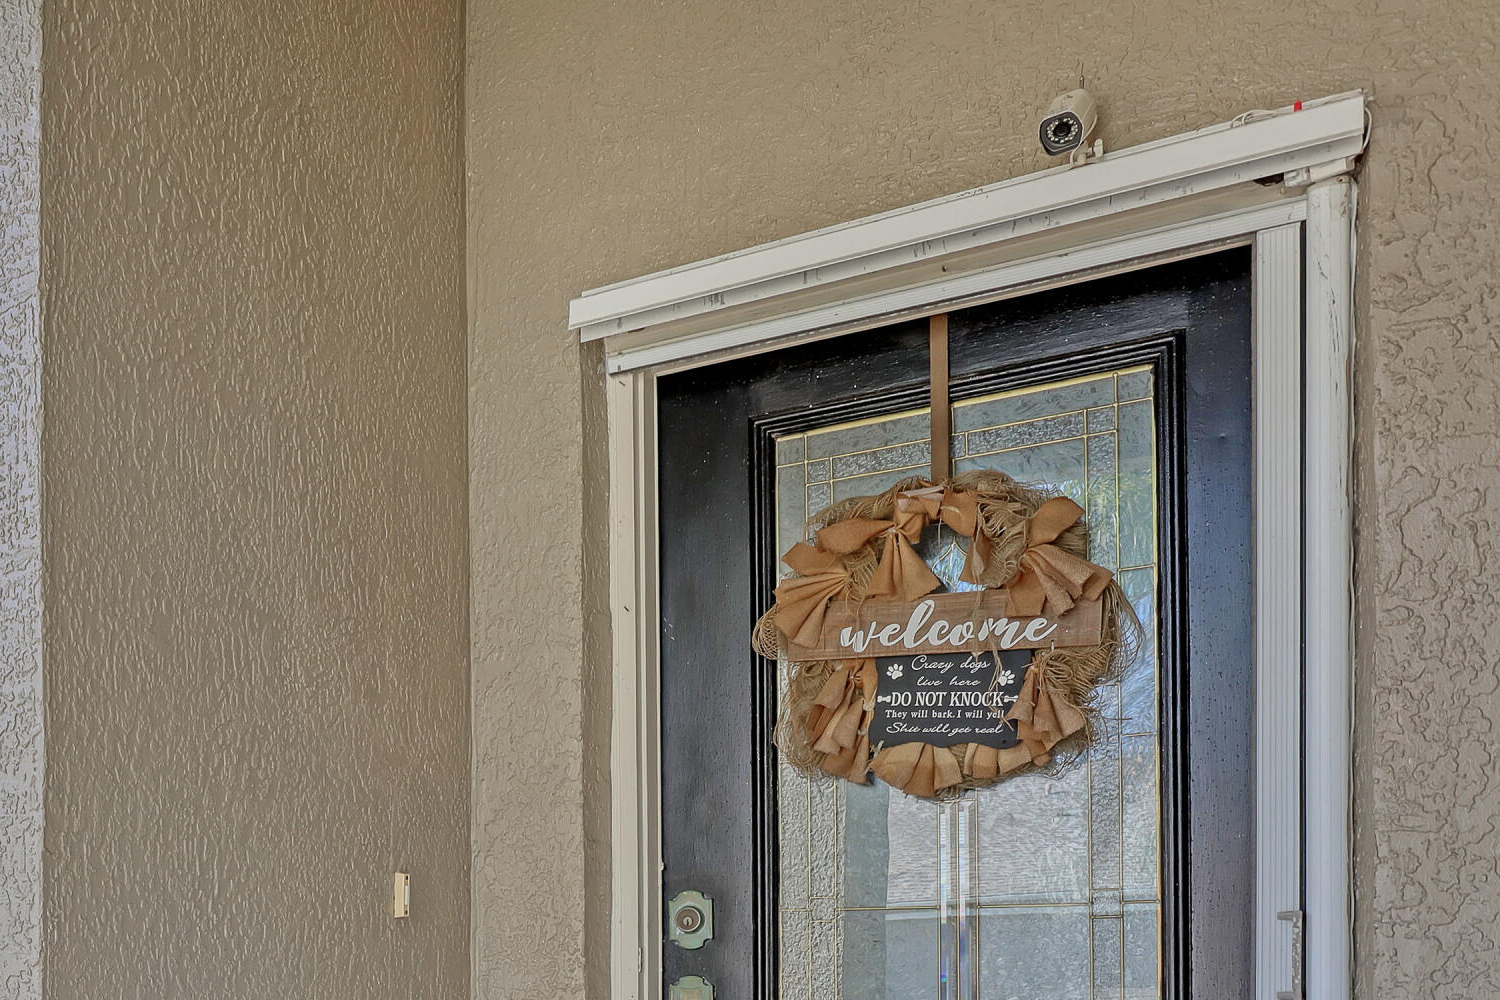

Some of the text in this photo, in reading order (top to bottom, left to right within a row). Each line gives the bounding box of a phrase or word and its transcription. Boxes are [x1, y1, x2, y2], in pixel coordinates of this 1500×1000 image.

[840, 600, 1058, 653] welcome
[911, 655, 991, 674] Crazy dogs
[916, 676, 981, 686] live here
[890, 691, 1004, 707] DO NOT KNOCK
[885, 710, 1005, 720] They will bark. I will yell
[886, 722, 1003, 737] Shit will get real
